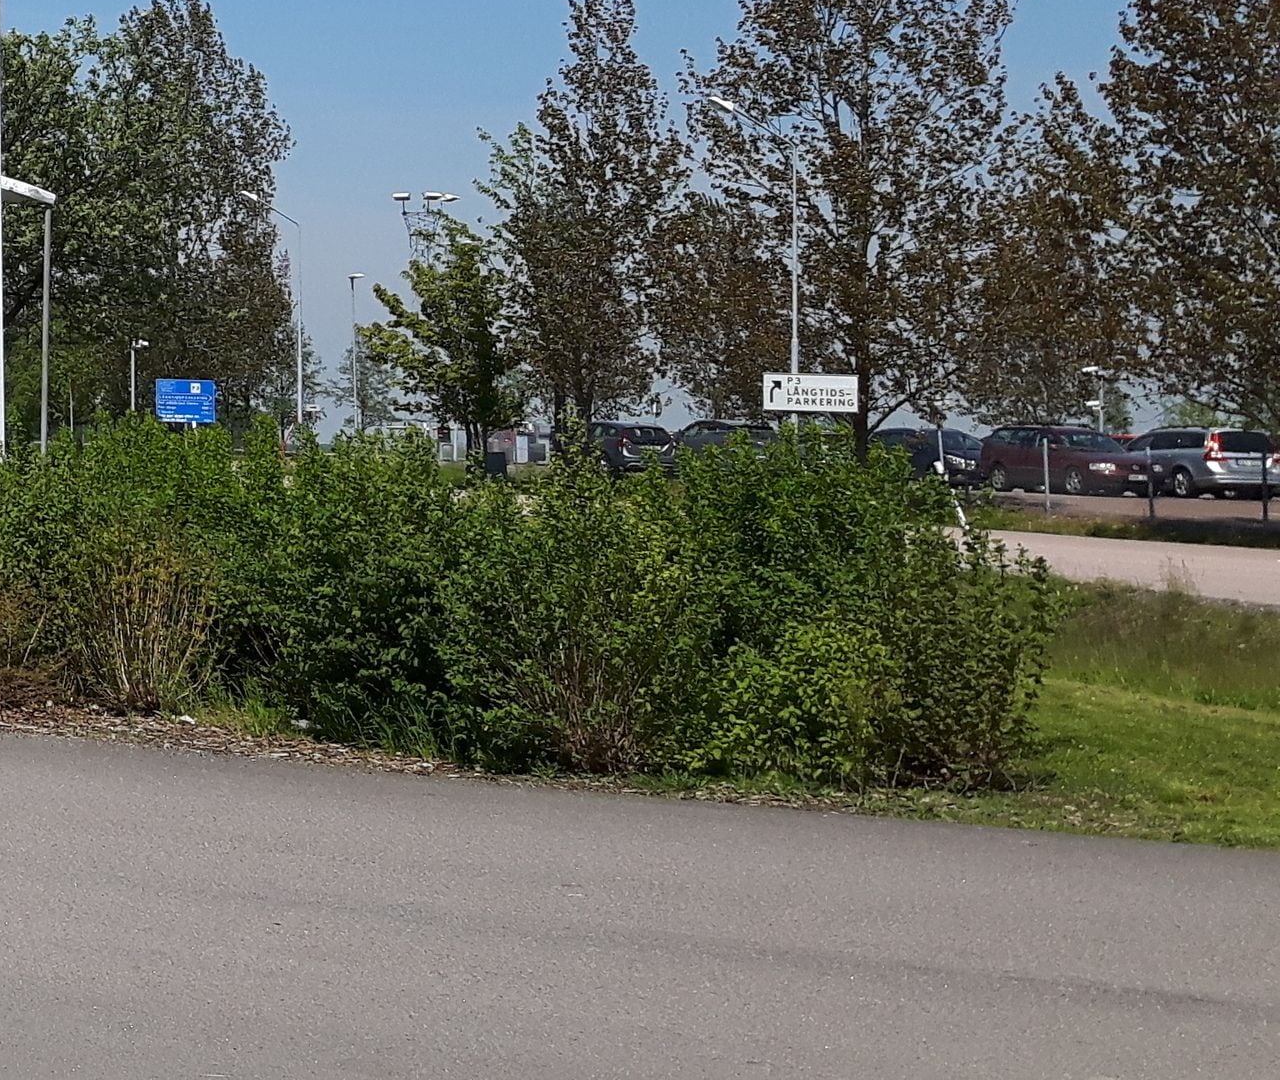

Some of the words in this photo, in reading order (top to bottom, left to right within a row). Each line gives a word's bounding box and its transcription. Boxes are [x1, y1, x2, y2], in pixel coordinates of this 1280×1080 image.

[787, 377, 801, 385] P3
[787, 386, 852, 397] LÅNGTIDS-
[787, 397, 855, 407] PARKERING
